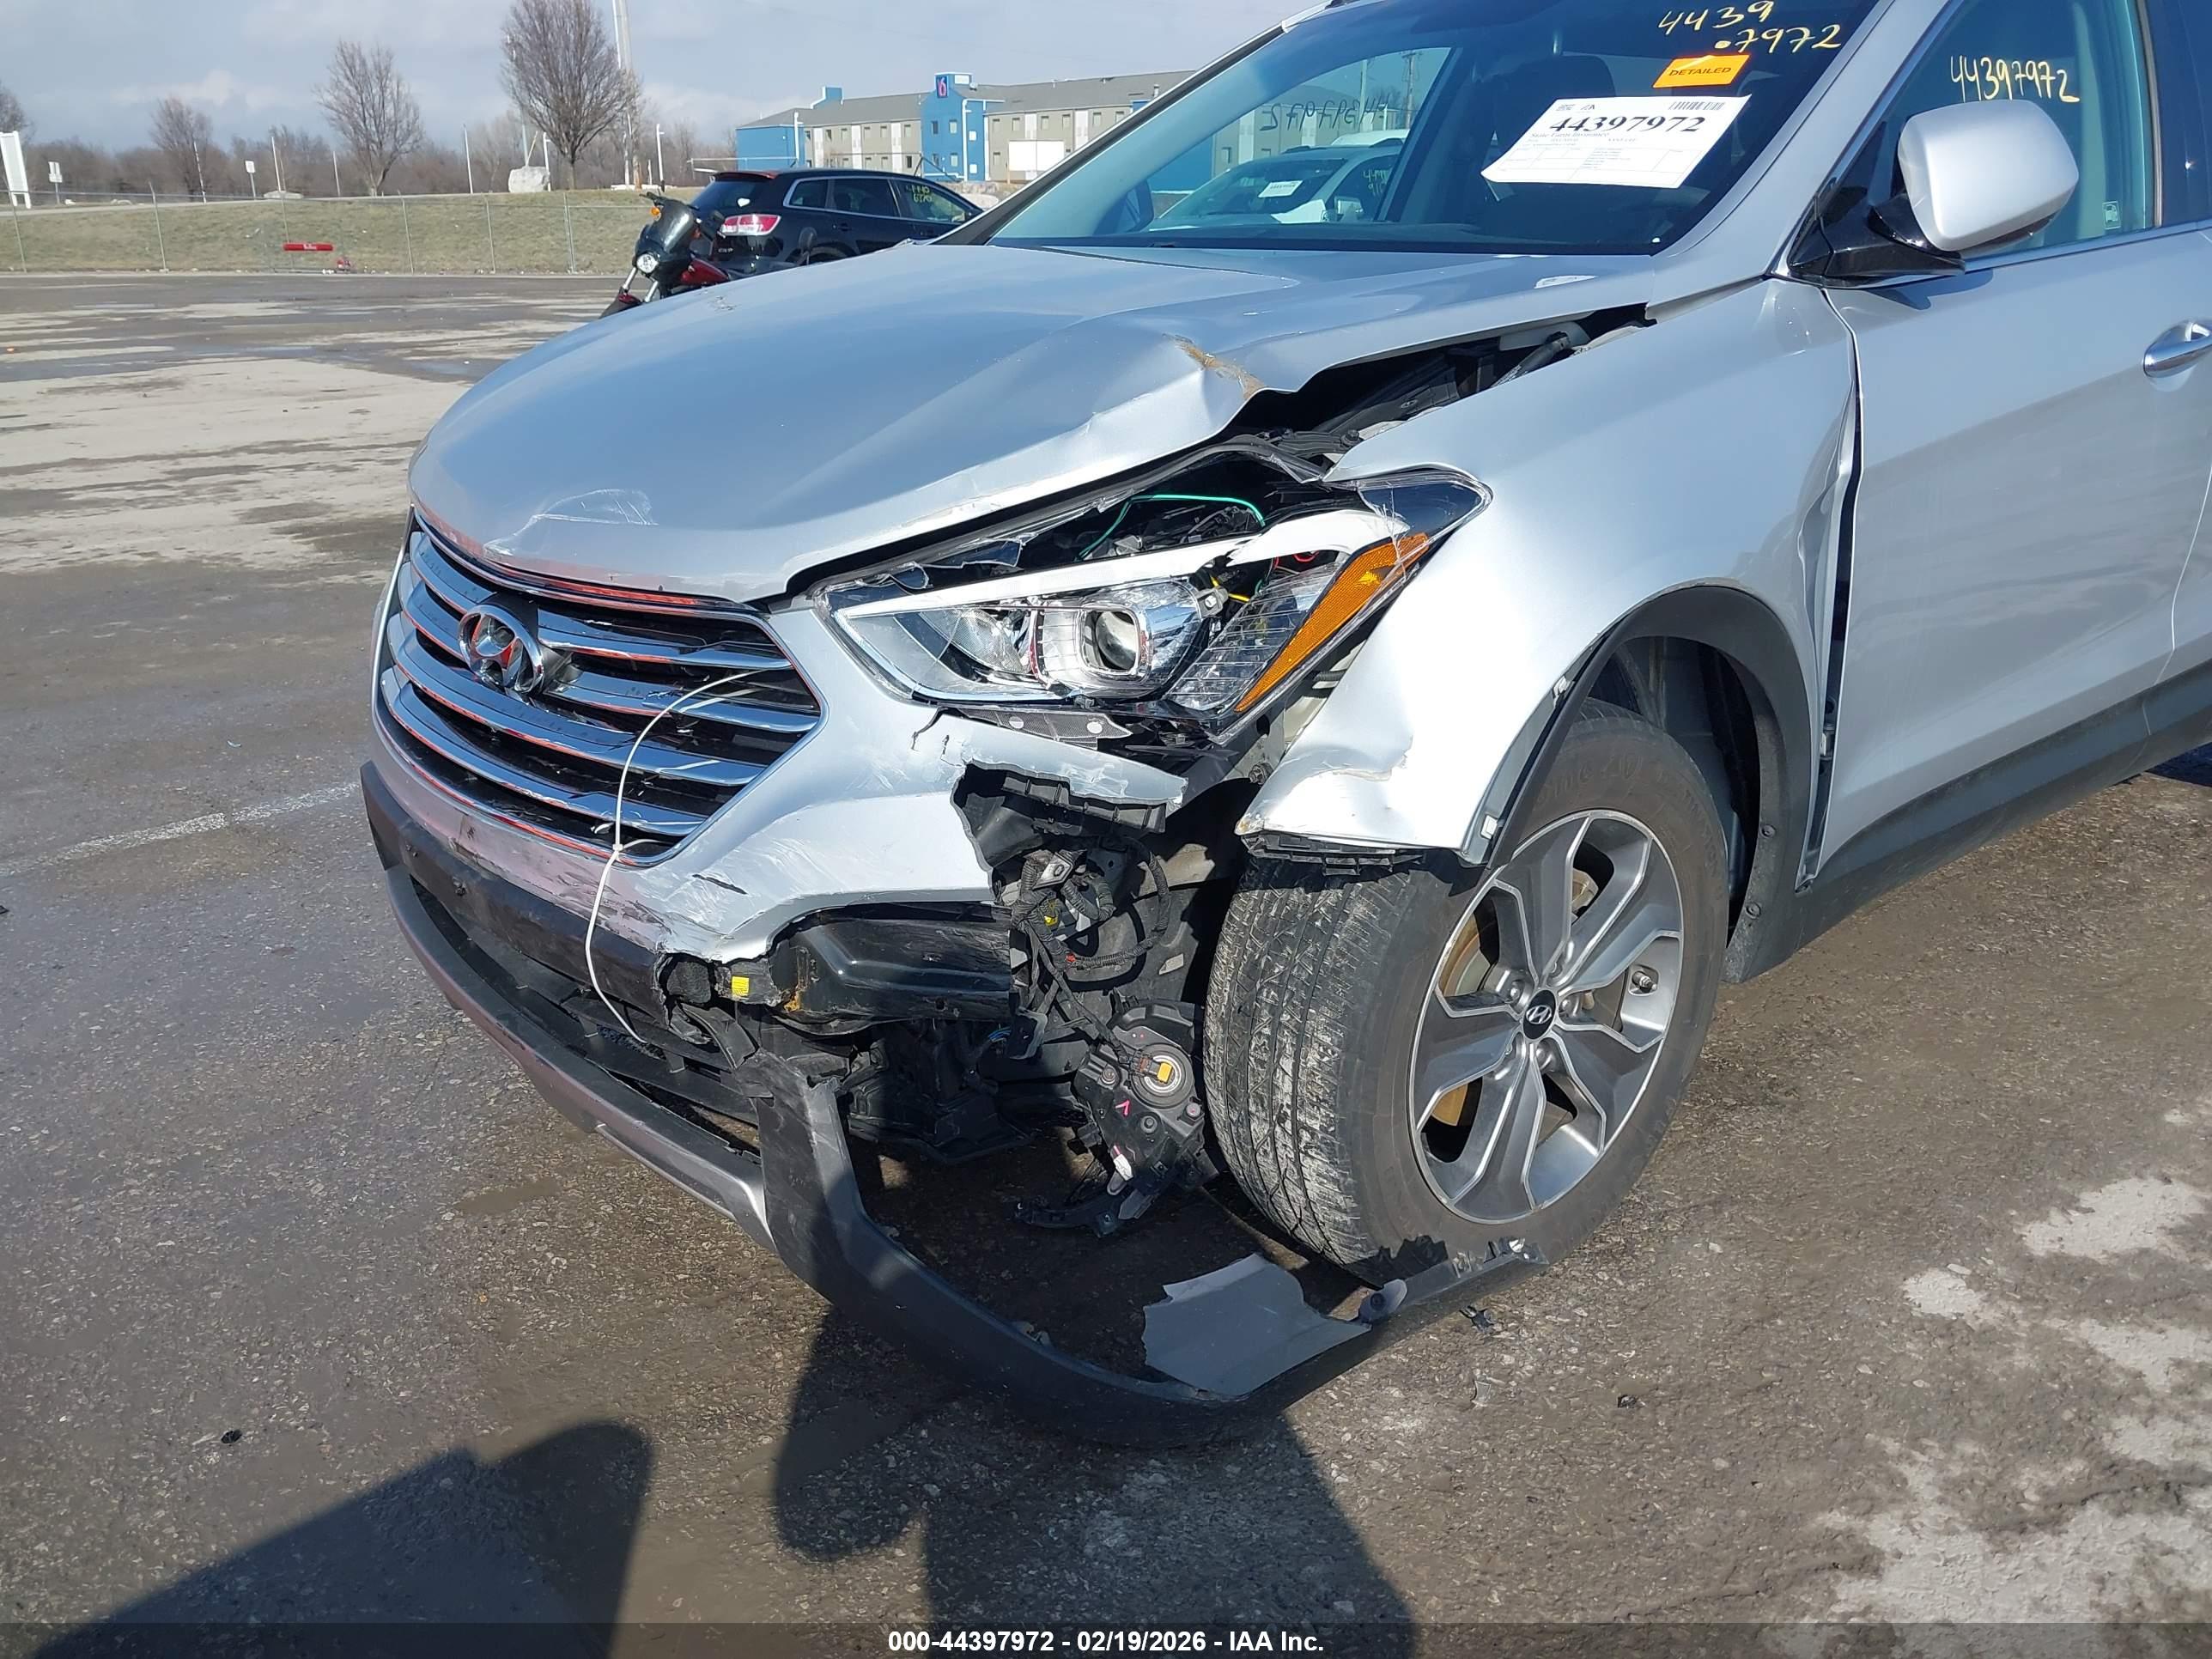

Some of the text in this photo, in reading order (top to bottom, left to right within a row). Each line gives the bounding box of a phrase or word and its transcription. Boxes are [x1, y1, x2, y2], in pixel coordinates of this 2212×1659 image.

[1658, 0, 1774, 35] 4439
[1668, 66, 1732, 76] DETAILED
[1950, 55, 2081, 102] 44397972
[1549, 116, 1706, 132] 44397972
